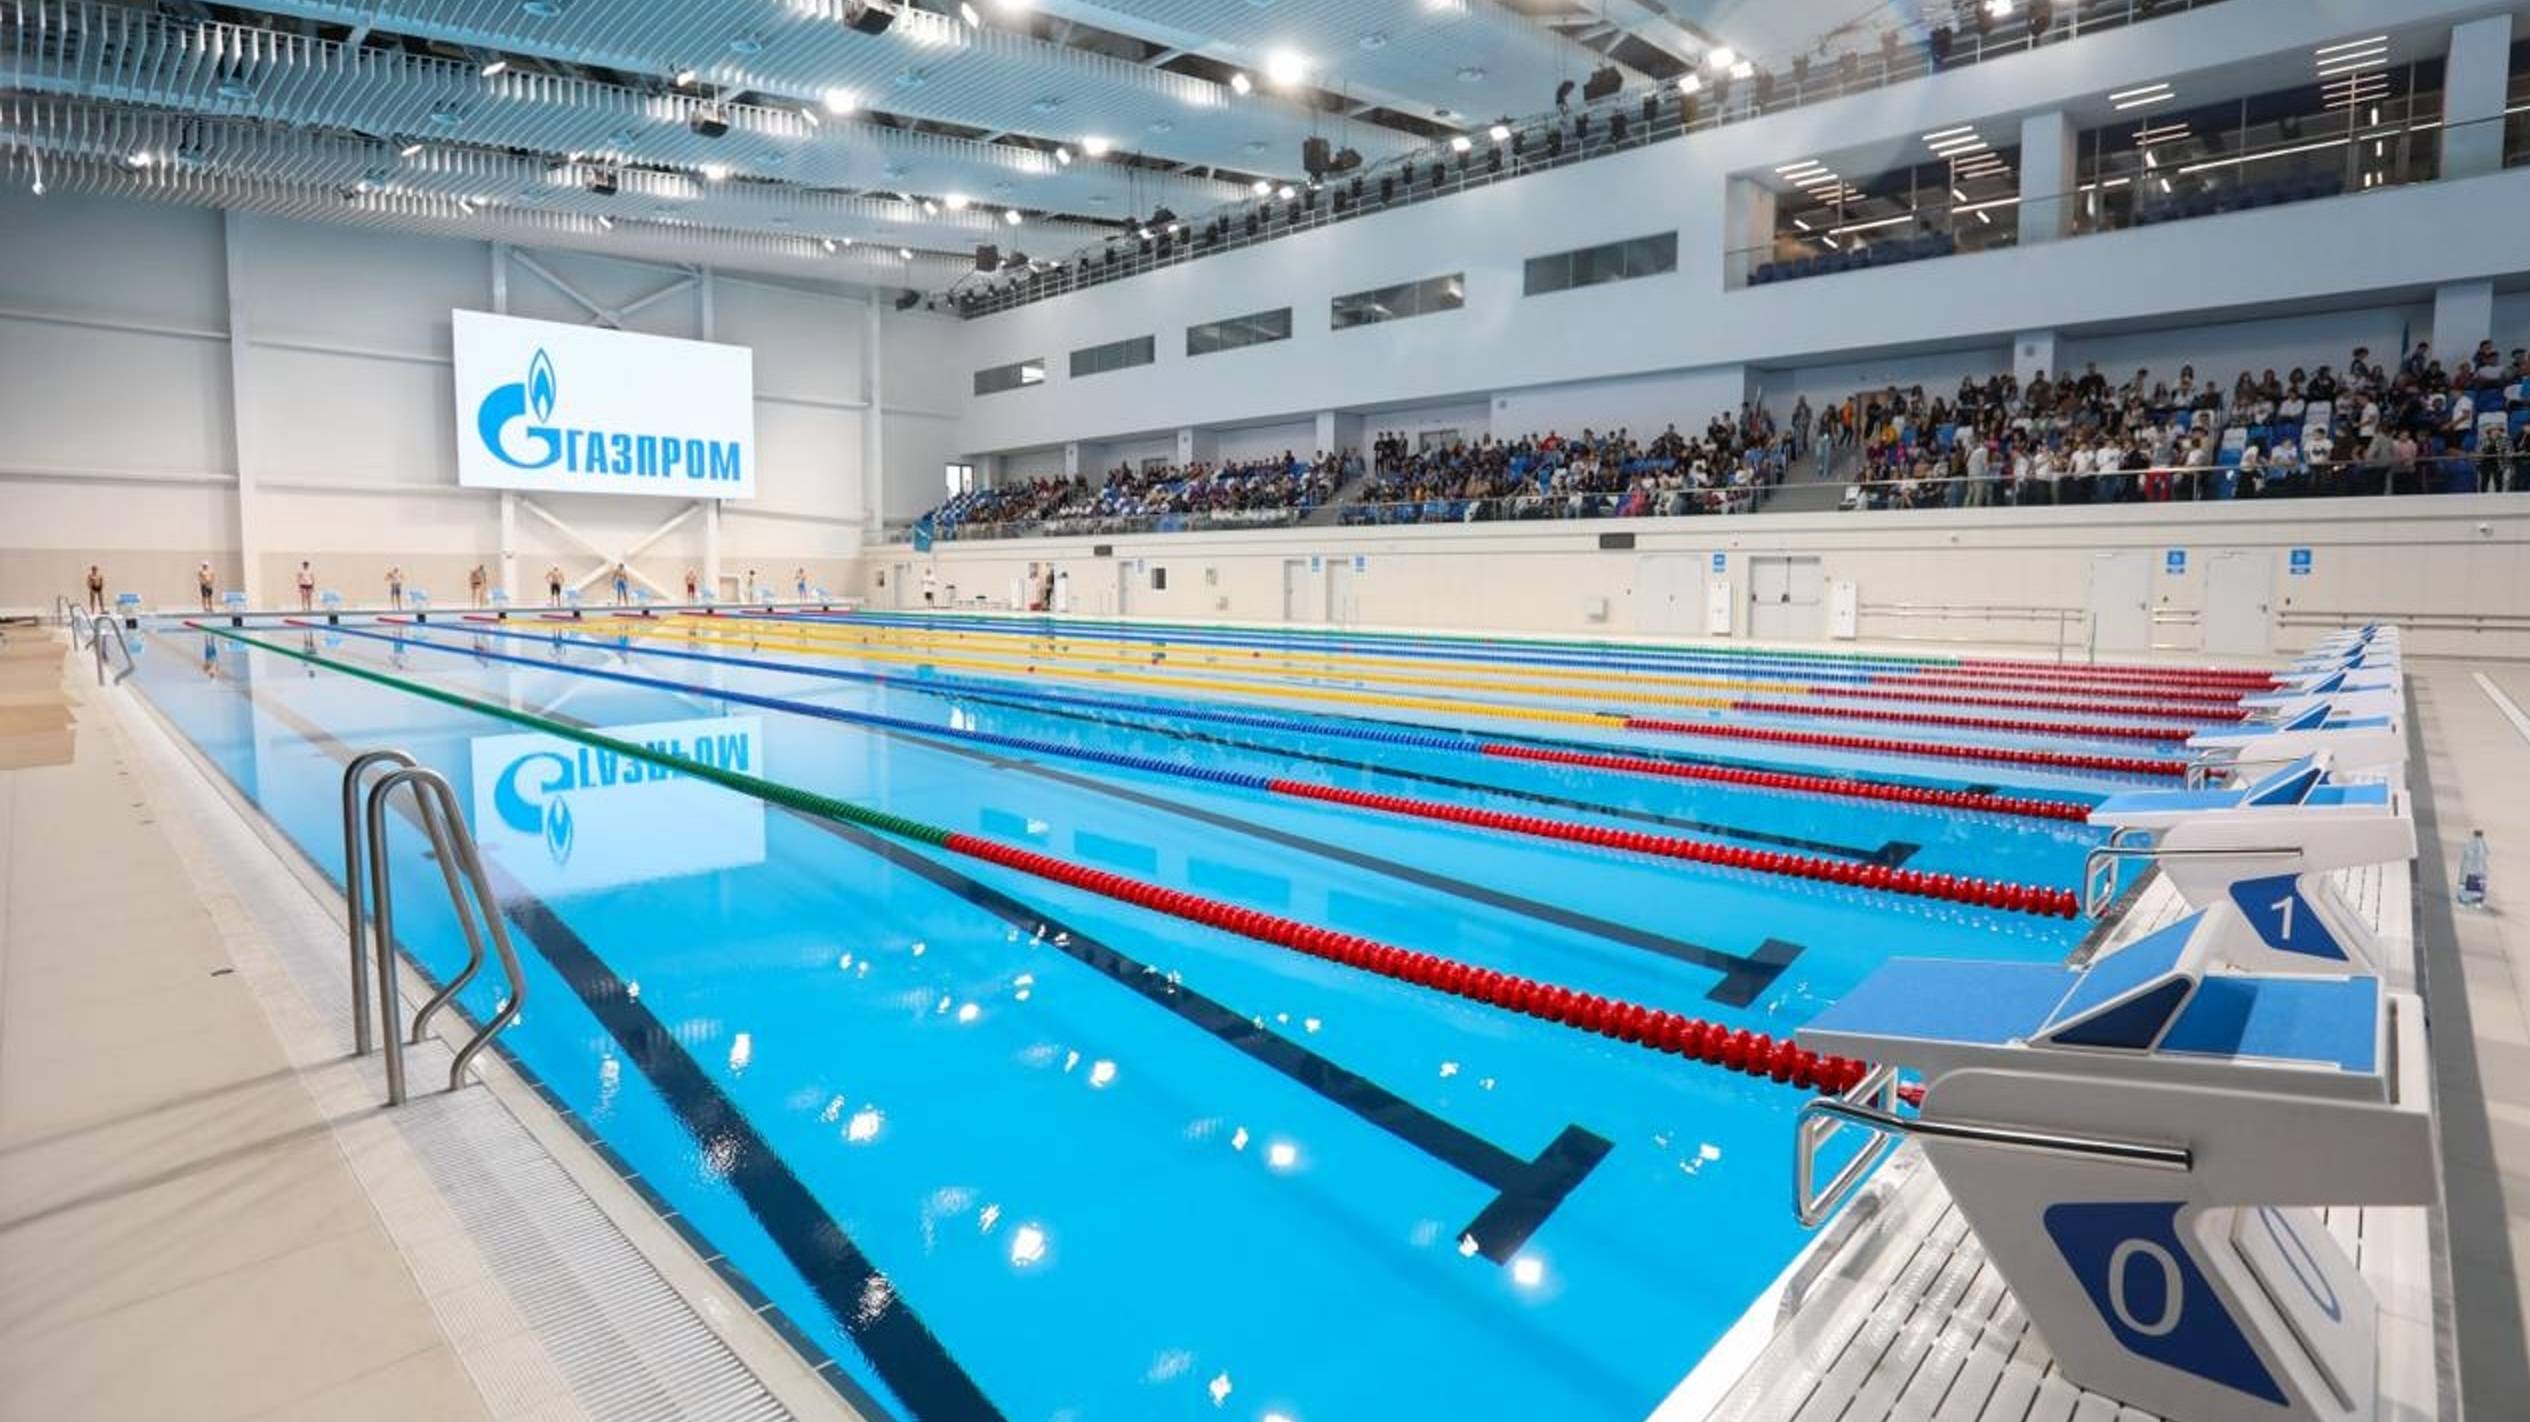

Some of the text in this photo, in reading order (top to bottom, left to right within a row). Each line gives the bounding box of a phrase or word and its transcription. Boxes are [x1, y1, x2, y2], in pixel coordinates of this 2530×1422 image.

[566, 429, 741, 481] ГАЗПРОМ
[2271, 896, 2293, 940] 1
[2108, 1238, 2184, 1336] 0
